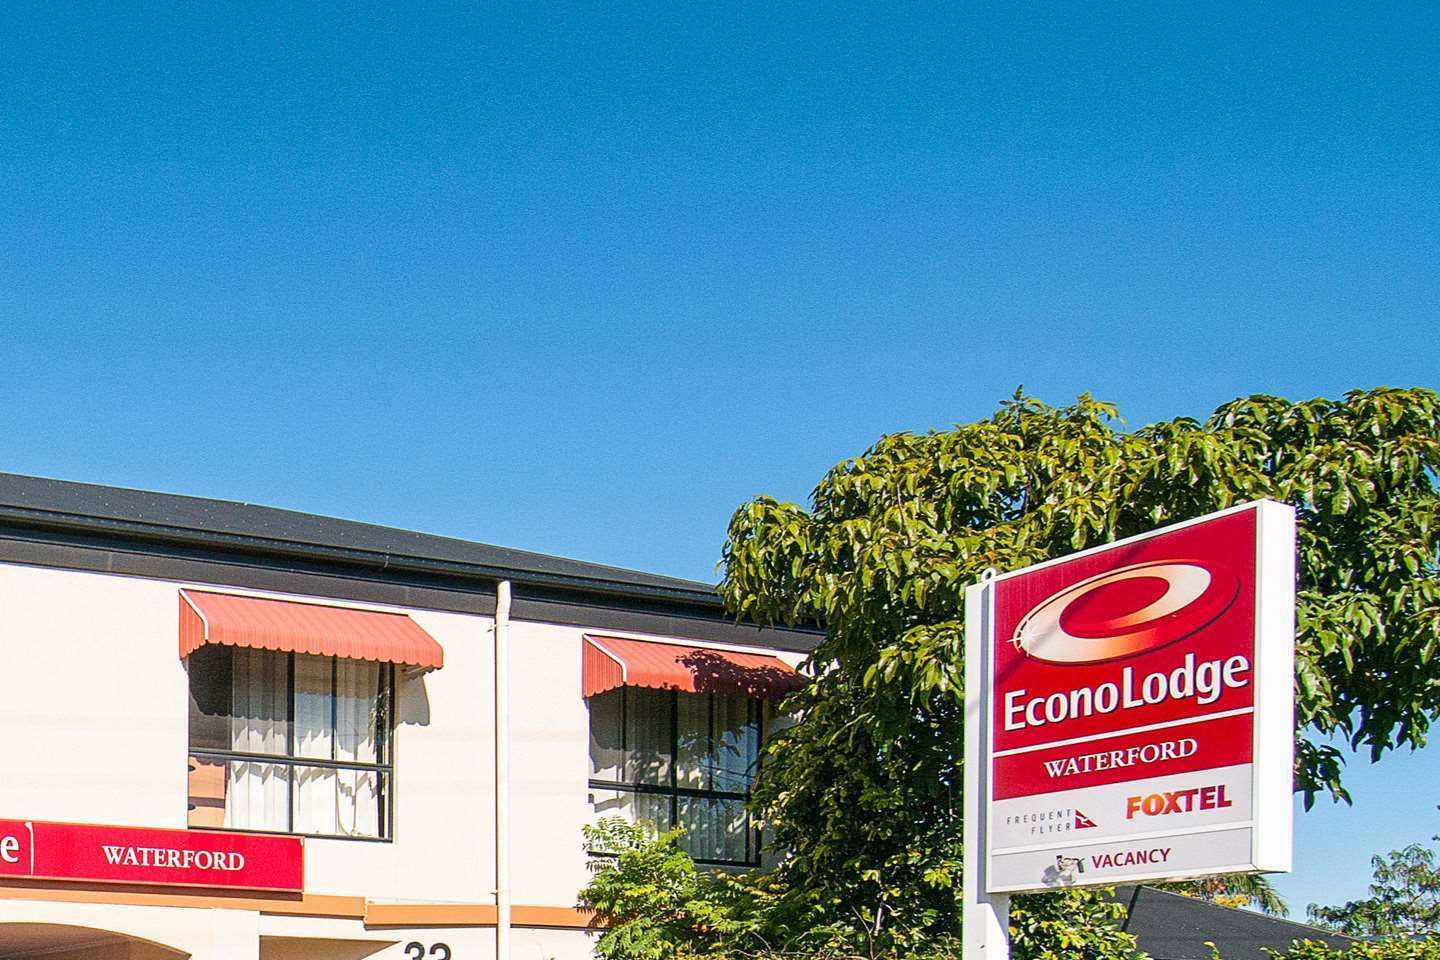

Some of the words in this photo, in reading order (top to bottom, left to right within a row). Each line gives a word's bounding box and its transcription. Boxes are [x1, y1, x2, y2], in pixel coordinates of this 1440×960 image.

[1004, 653, 1250, 731] EconoLodge
[1043, 738, 1198, 779] WATERFORD
[1126, 784, 1232, 820] FOXTEL
[1006, 809, 1071, 825] FREQUENT
[1031, 822, 1071, 835] FLYER
[102, 845, 246, 871] WATERFORD
[1091, 848, 1171, 869] VACANCY
